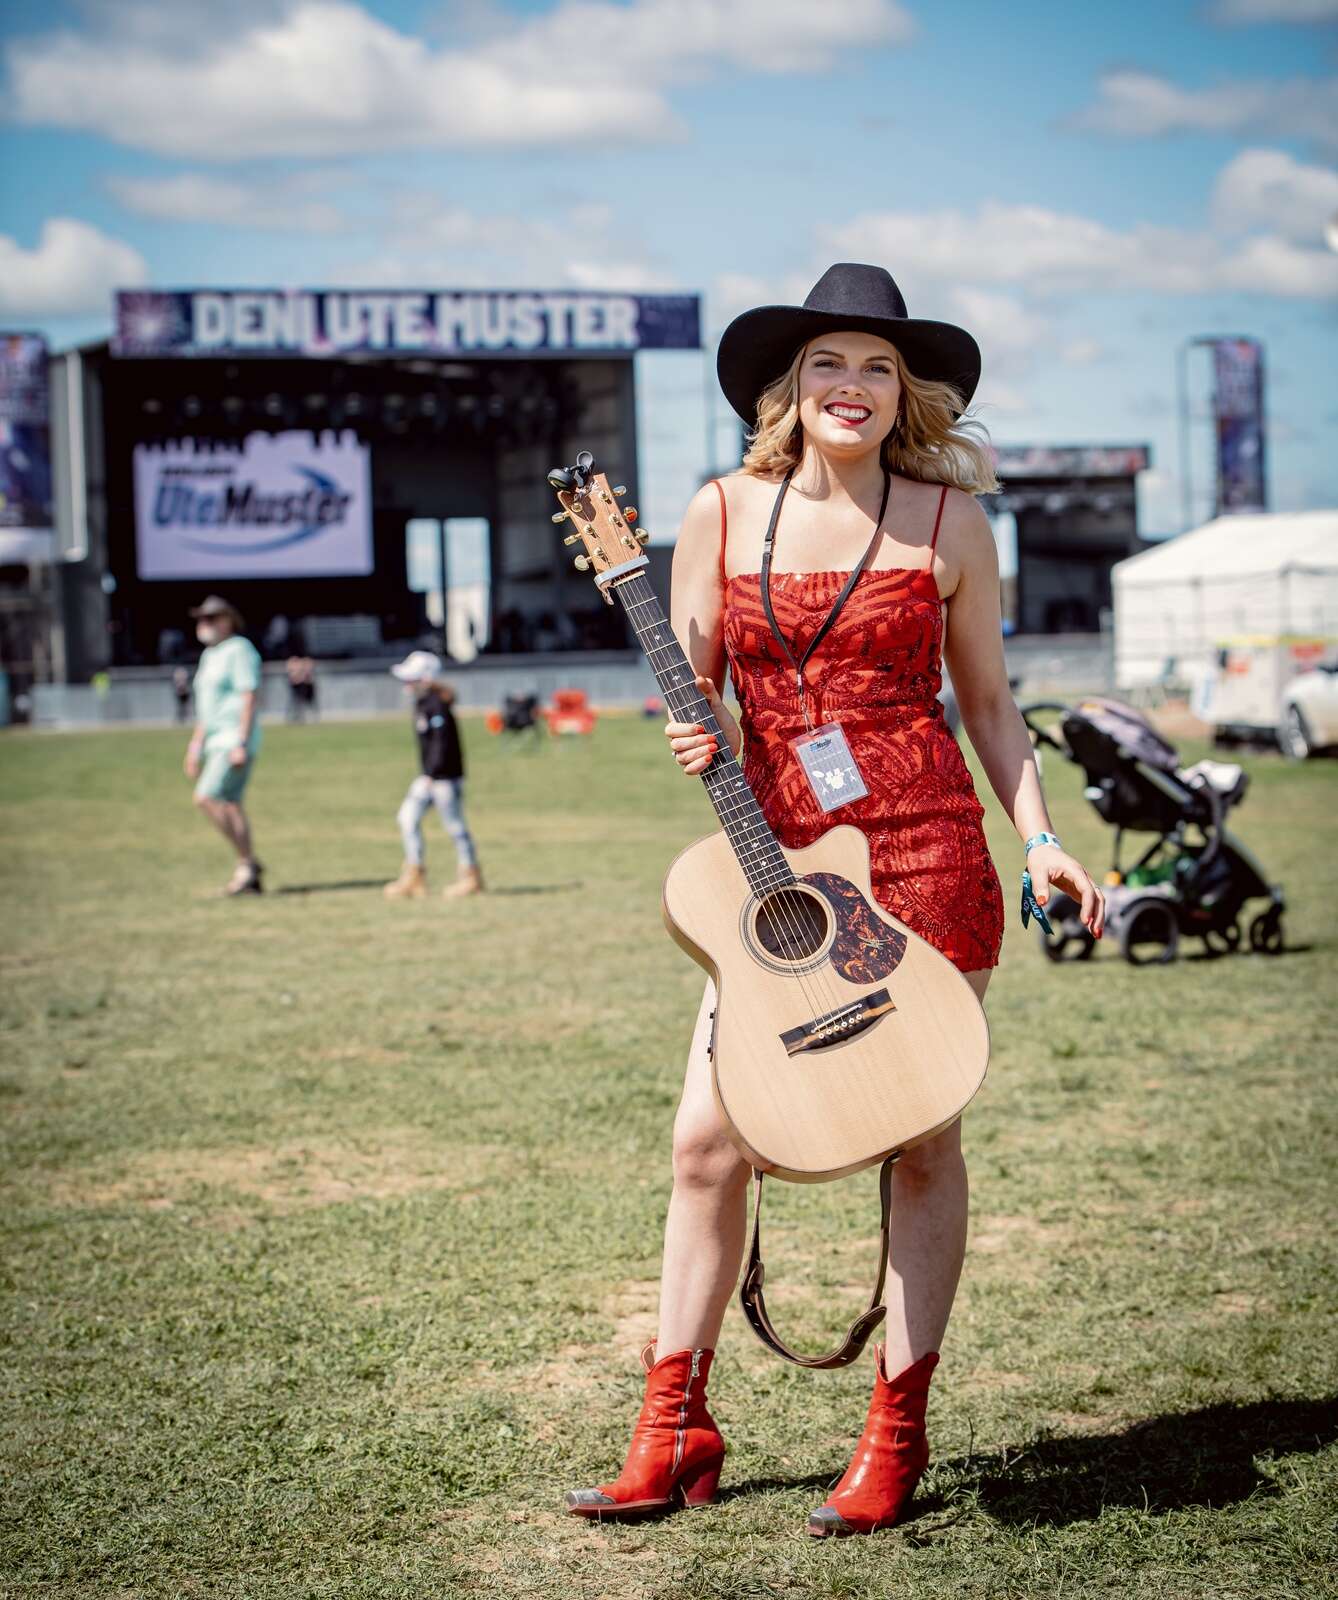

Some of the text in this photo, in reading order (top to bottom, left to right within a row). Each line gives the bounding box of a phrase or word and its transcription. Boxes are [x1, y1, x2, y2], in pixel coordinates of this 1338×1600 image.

[193, 294, 638, 348] DENI UTE MUSTER
[153, 482, 352, 526] UteMuster
[1027, 896, 1043, 920] ADULT
